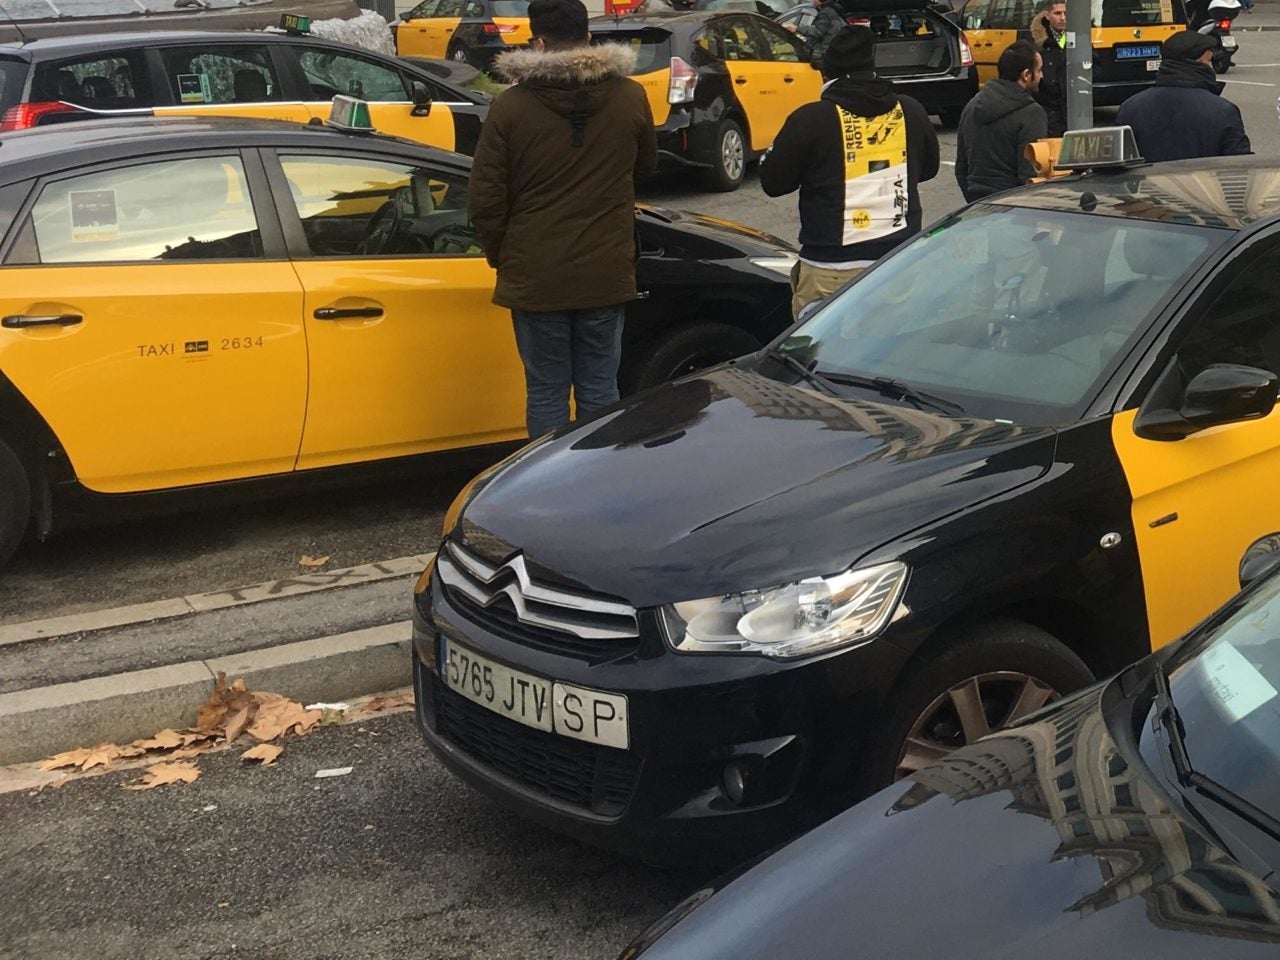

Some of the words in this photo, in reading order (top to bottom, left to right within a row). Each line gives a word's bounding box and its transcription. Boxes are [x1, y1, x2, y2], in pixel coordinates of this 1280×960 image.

[1073, 135, 1100, 159] TAXI
[137, 344, 175, 357] TAXI
[220, 336, 264, 351] 2634
[204, 563, 394, 601] TAXI
[450, 648, 495, 703] 5765
[503, 677, 546, 723] JTV
[563, 693, 616, 737] SP
